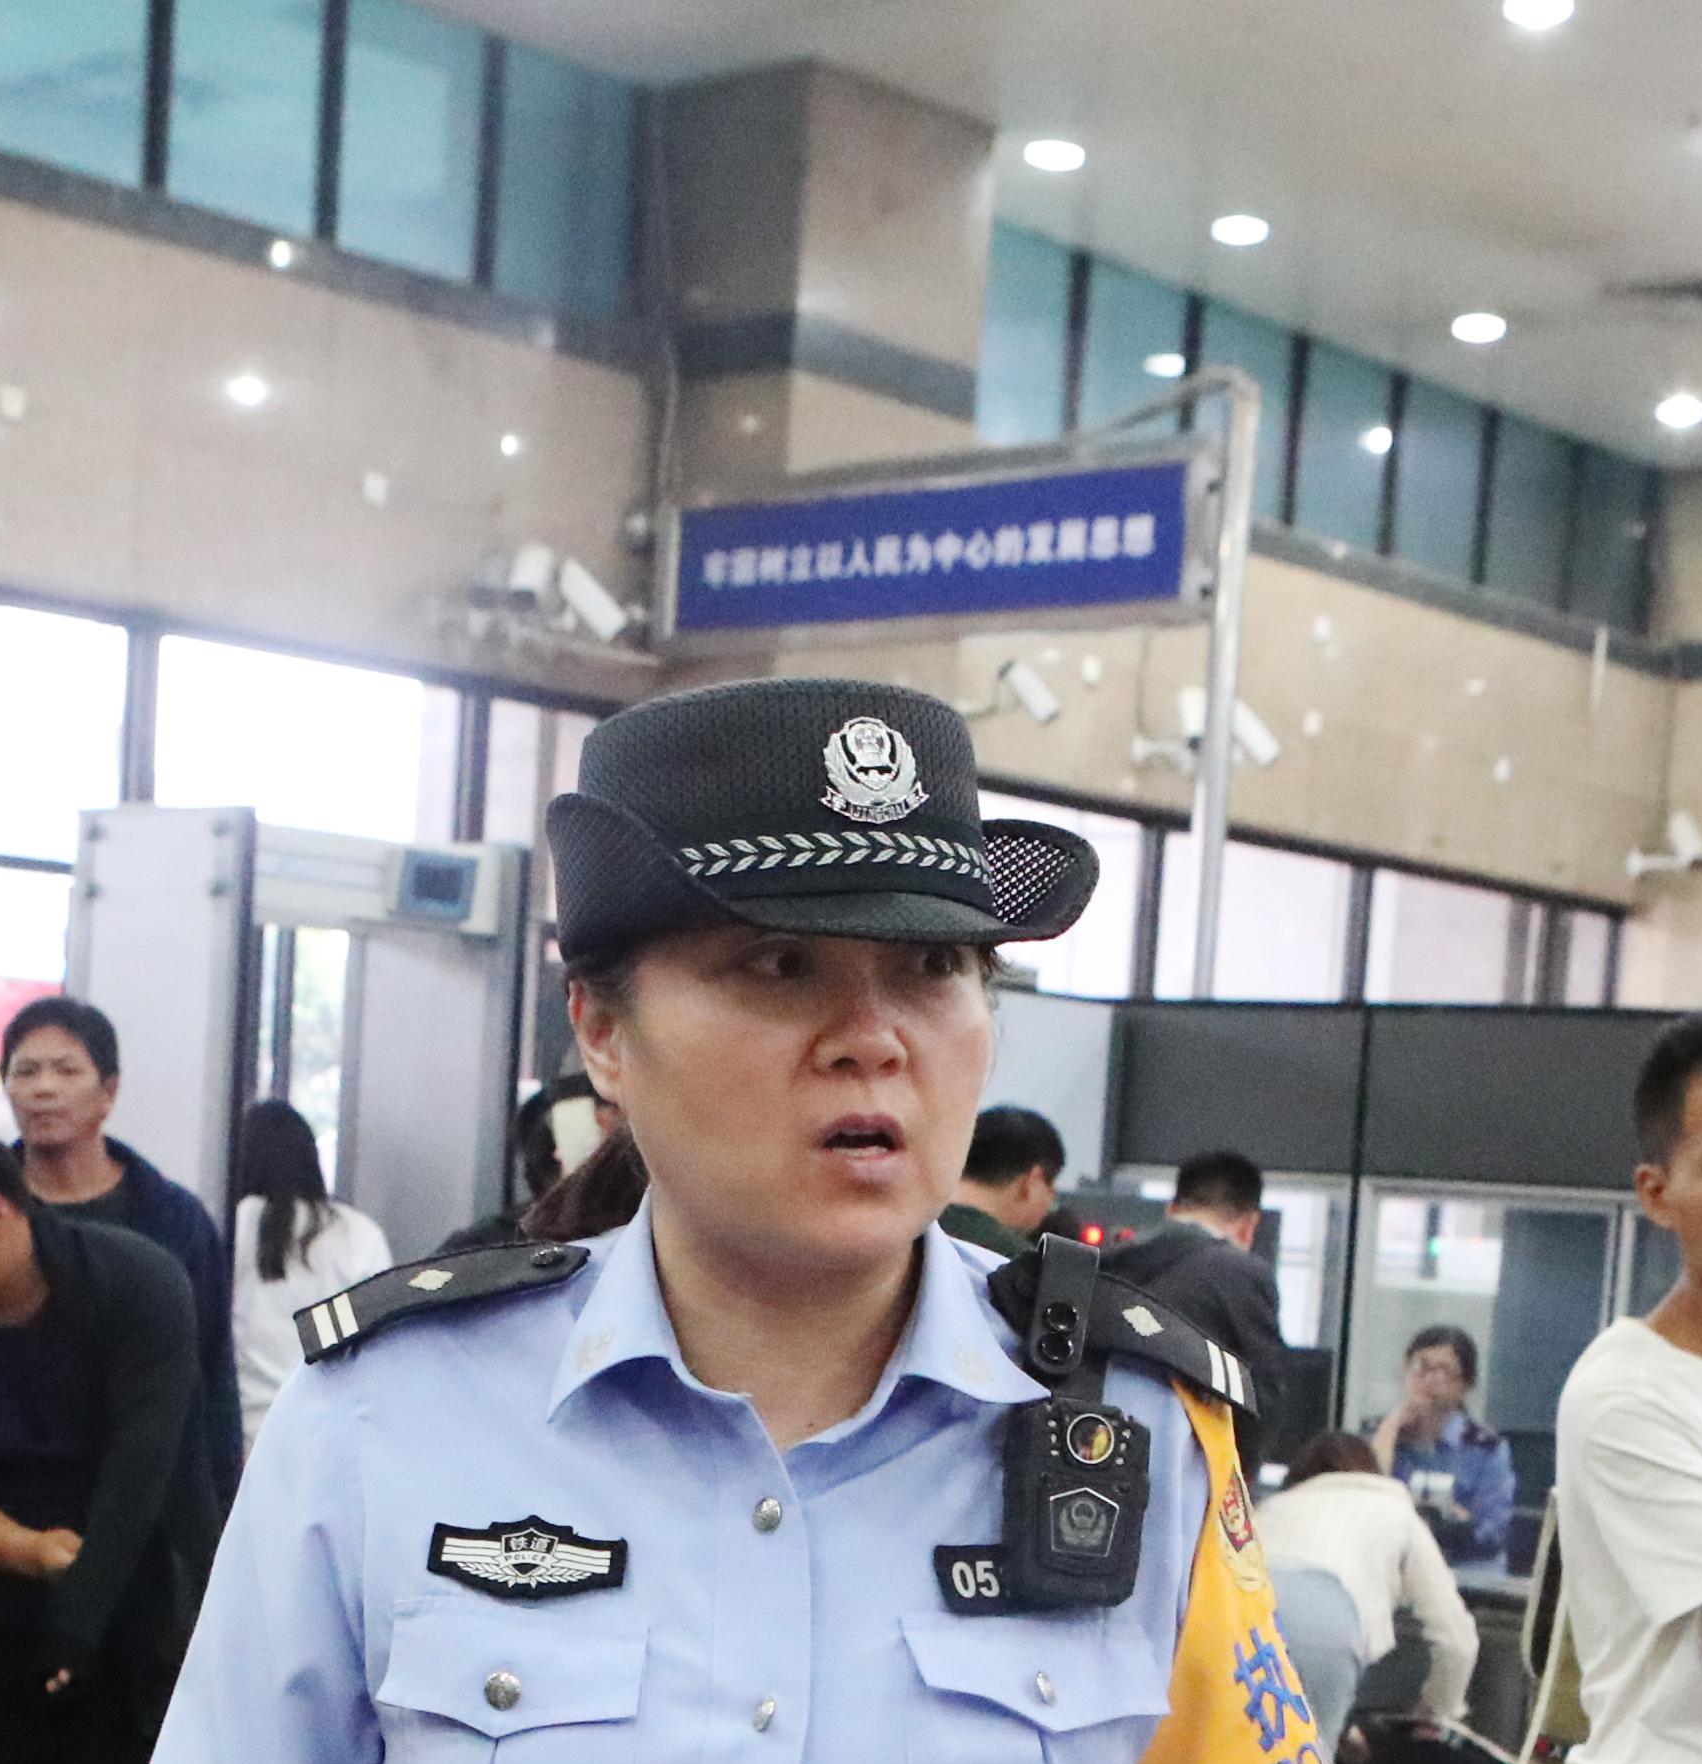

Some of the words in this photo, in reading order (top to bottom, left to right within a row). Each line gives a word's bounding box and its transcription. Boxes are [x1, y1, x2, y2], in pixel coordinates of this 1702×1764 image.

[505, 1554, 547, 1562] POLICE
[510, 1537, 550, 1552] 铁道
[951, 1560, 1001, 1599] 05
[1234, 1612, 1310, 1751] 执
